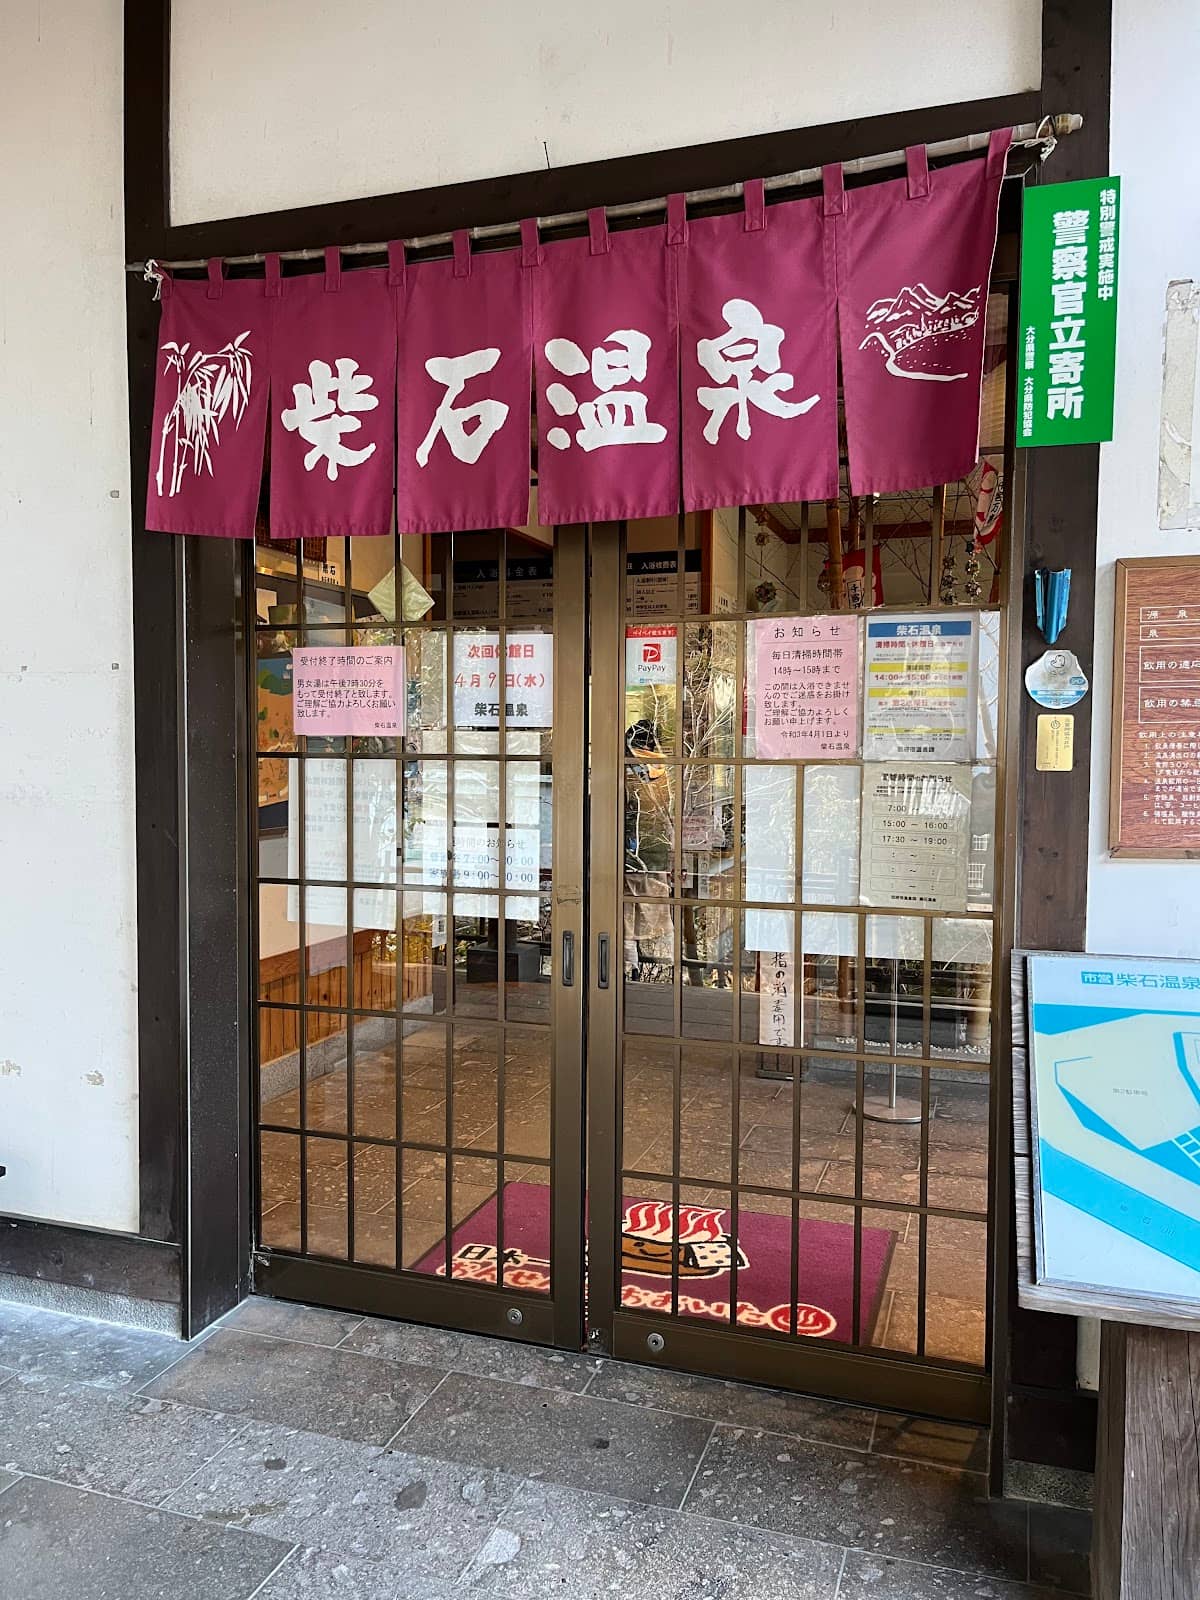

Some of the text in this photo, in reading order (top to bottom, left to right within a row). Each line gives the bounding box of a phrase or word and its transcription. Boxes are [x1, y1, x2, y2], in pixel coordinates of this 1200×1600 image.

[1098, 189, 1116, 301] 特別警戒実施中
[1047, 210, 1089, 420] 警察官立寄所
[281, 298, 821, 483] 柴石温泉
[774, 625, 841, 639] お知らせ
[300, 655, 394, 666] 受付終了時間のご案内
[772, 648, 844, 660] 毎日清掃時間帯
[638, 665, 666, 673] PayPay
[882, 820, 906, 828] 15:00
[1115, 972, 1200, 990] 柴石温泉
